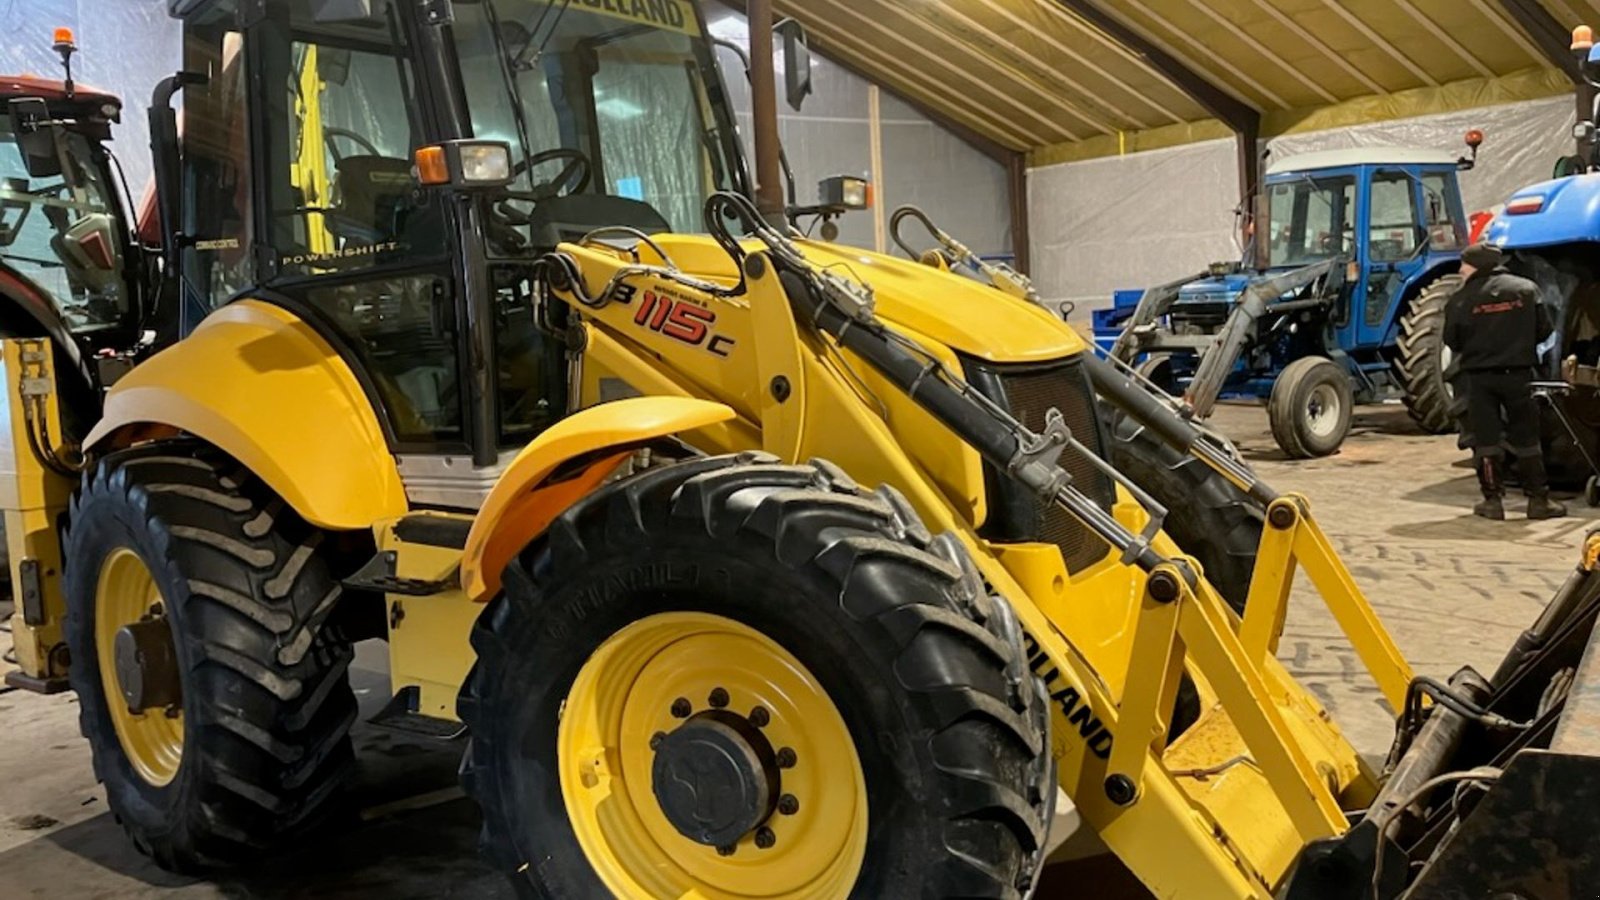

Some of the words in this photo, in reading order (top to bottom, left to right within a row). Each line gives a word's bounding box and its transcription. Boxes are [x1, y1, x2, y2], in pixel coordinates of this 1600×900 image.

[572, 0, 685, 28] LLAND
[282, 241, 398, 265] POWERSHIFT
[633, 290, 716, 345] 115
[706, 334, 736, 357] C
[1018, 619, 1114, 760] OLLAND
